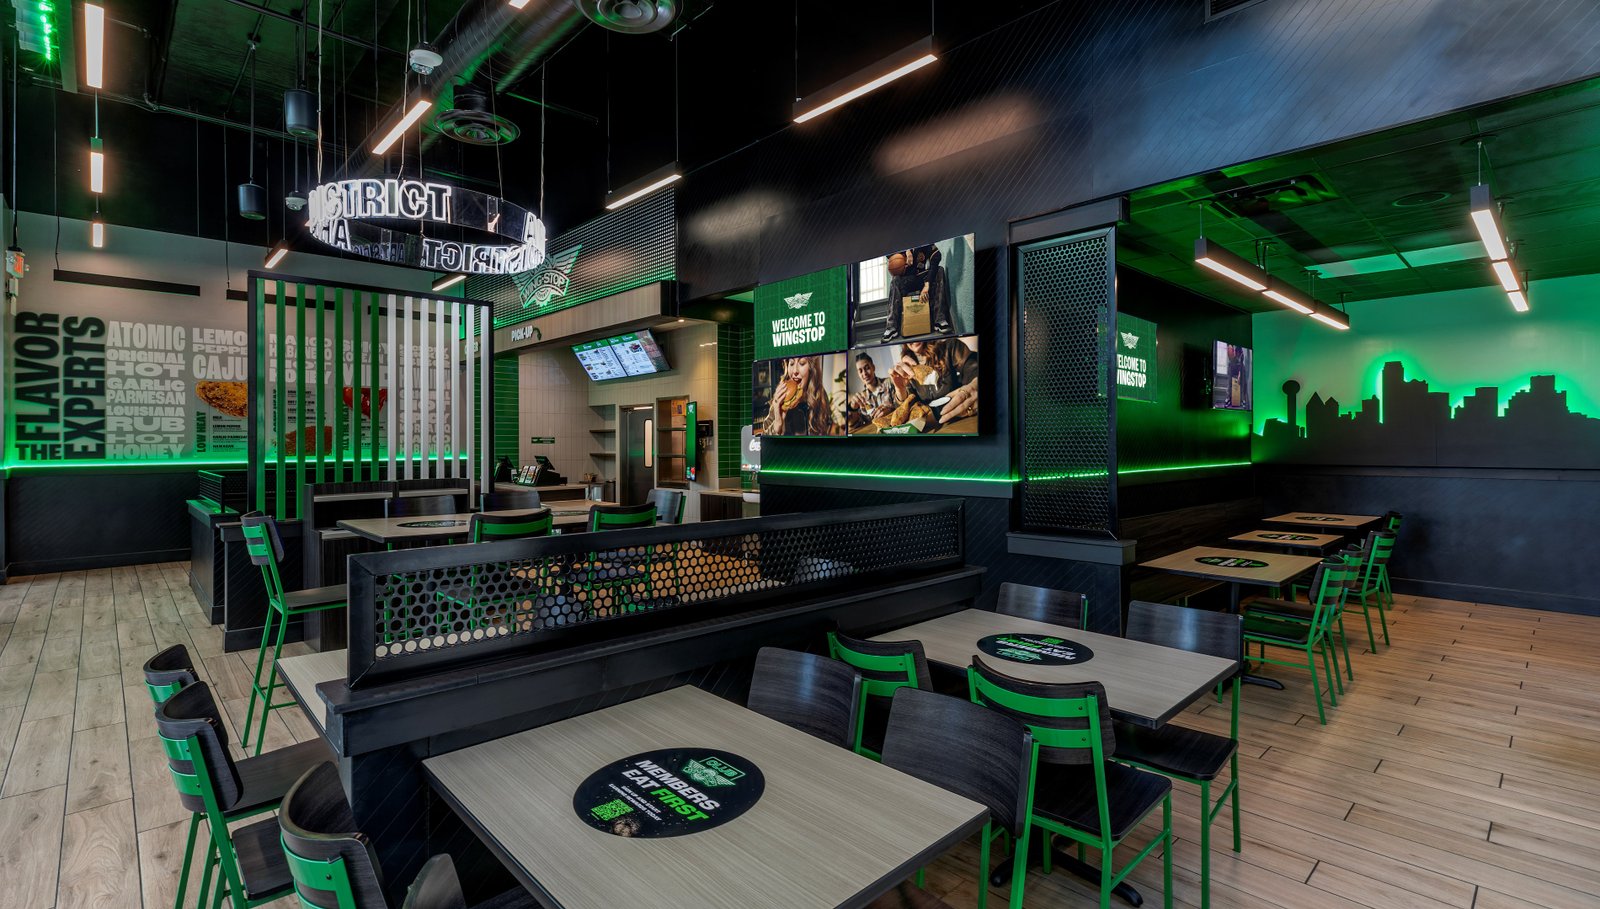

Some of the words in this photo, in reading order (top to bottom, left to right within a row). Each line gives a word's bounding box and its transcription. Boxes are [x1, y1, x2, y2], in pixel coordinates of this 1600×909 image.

[772, 313, 812, 333] WELCOME
[813, 311, 826, 326] TO
[107, 321, 186, 351] ATOMIC
[193, 328, 248, 346] LEMO
[512, 325, 533, 341] PICK-UP
[772, 326, 826, 347] WINGSTOP
[107, 349, 186, 364] ORIGINAL
[107, 361, 186, 377] HOT
[193, 354, 248, 380] CAJU
[1139, 358, 1147, 373] TO
[14, 311, 59, 441] FLAVOR
[62, 316, 105, 459] EXPERTS
[107, 378, 185, 392] GARLIC
[106, 390, 186, 405] PARMESAN
[106, 405, 186, 417] LOUISIANA
[107, 416, 186, 432] RUB
[196, 411, 206, 433] HEAT
[106, 433, 185, 444] HOT
[196, 434, 206, 453] LOW
[15, 444, 62, 460] THE
[106, 443, 185, 460] HONEY
[635, 760, 720, 810] MEMBERS
[622, 769, 661, 788] EAT
[650, 788, 710, 820] FIRST
